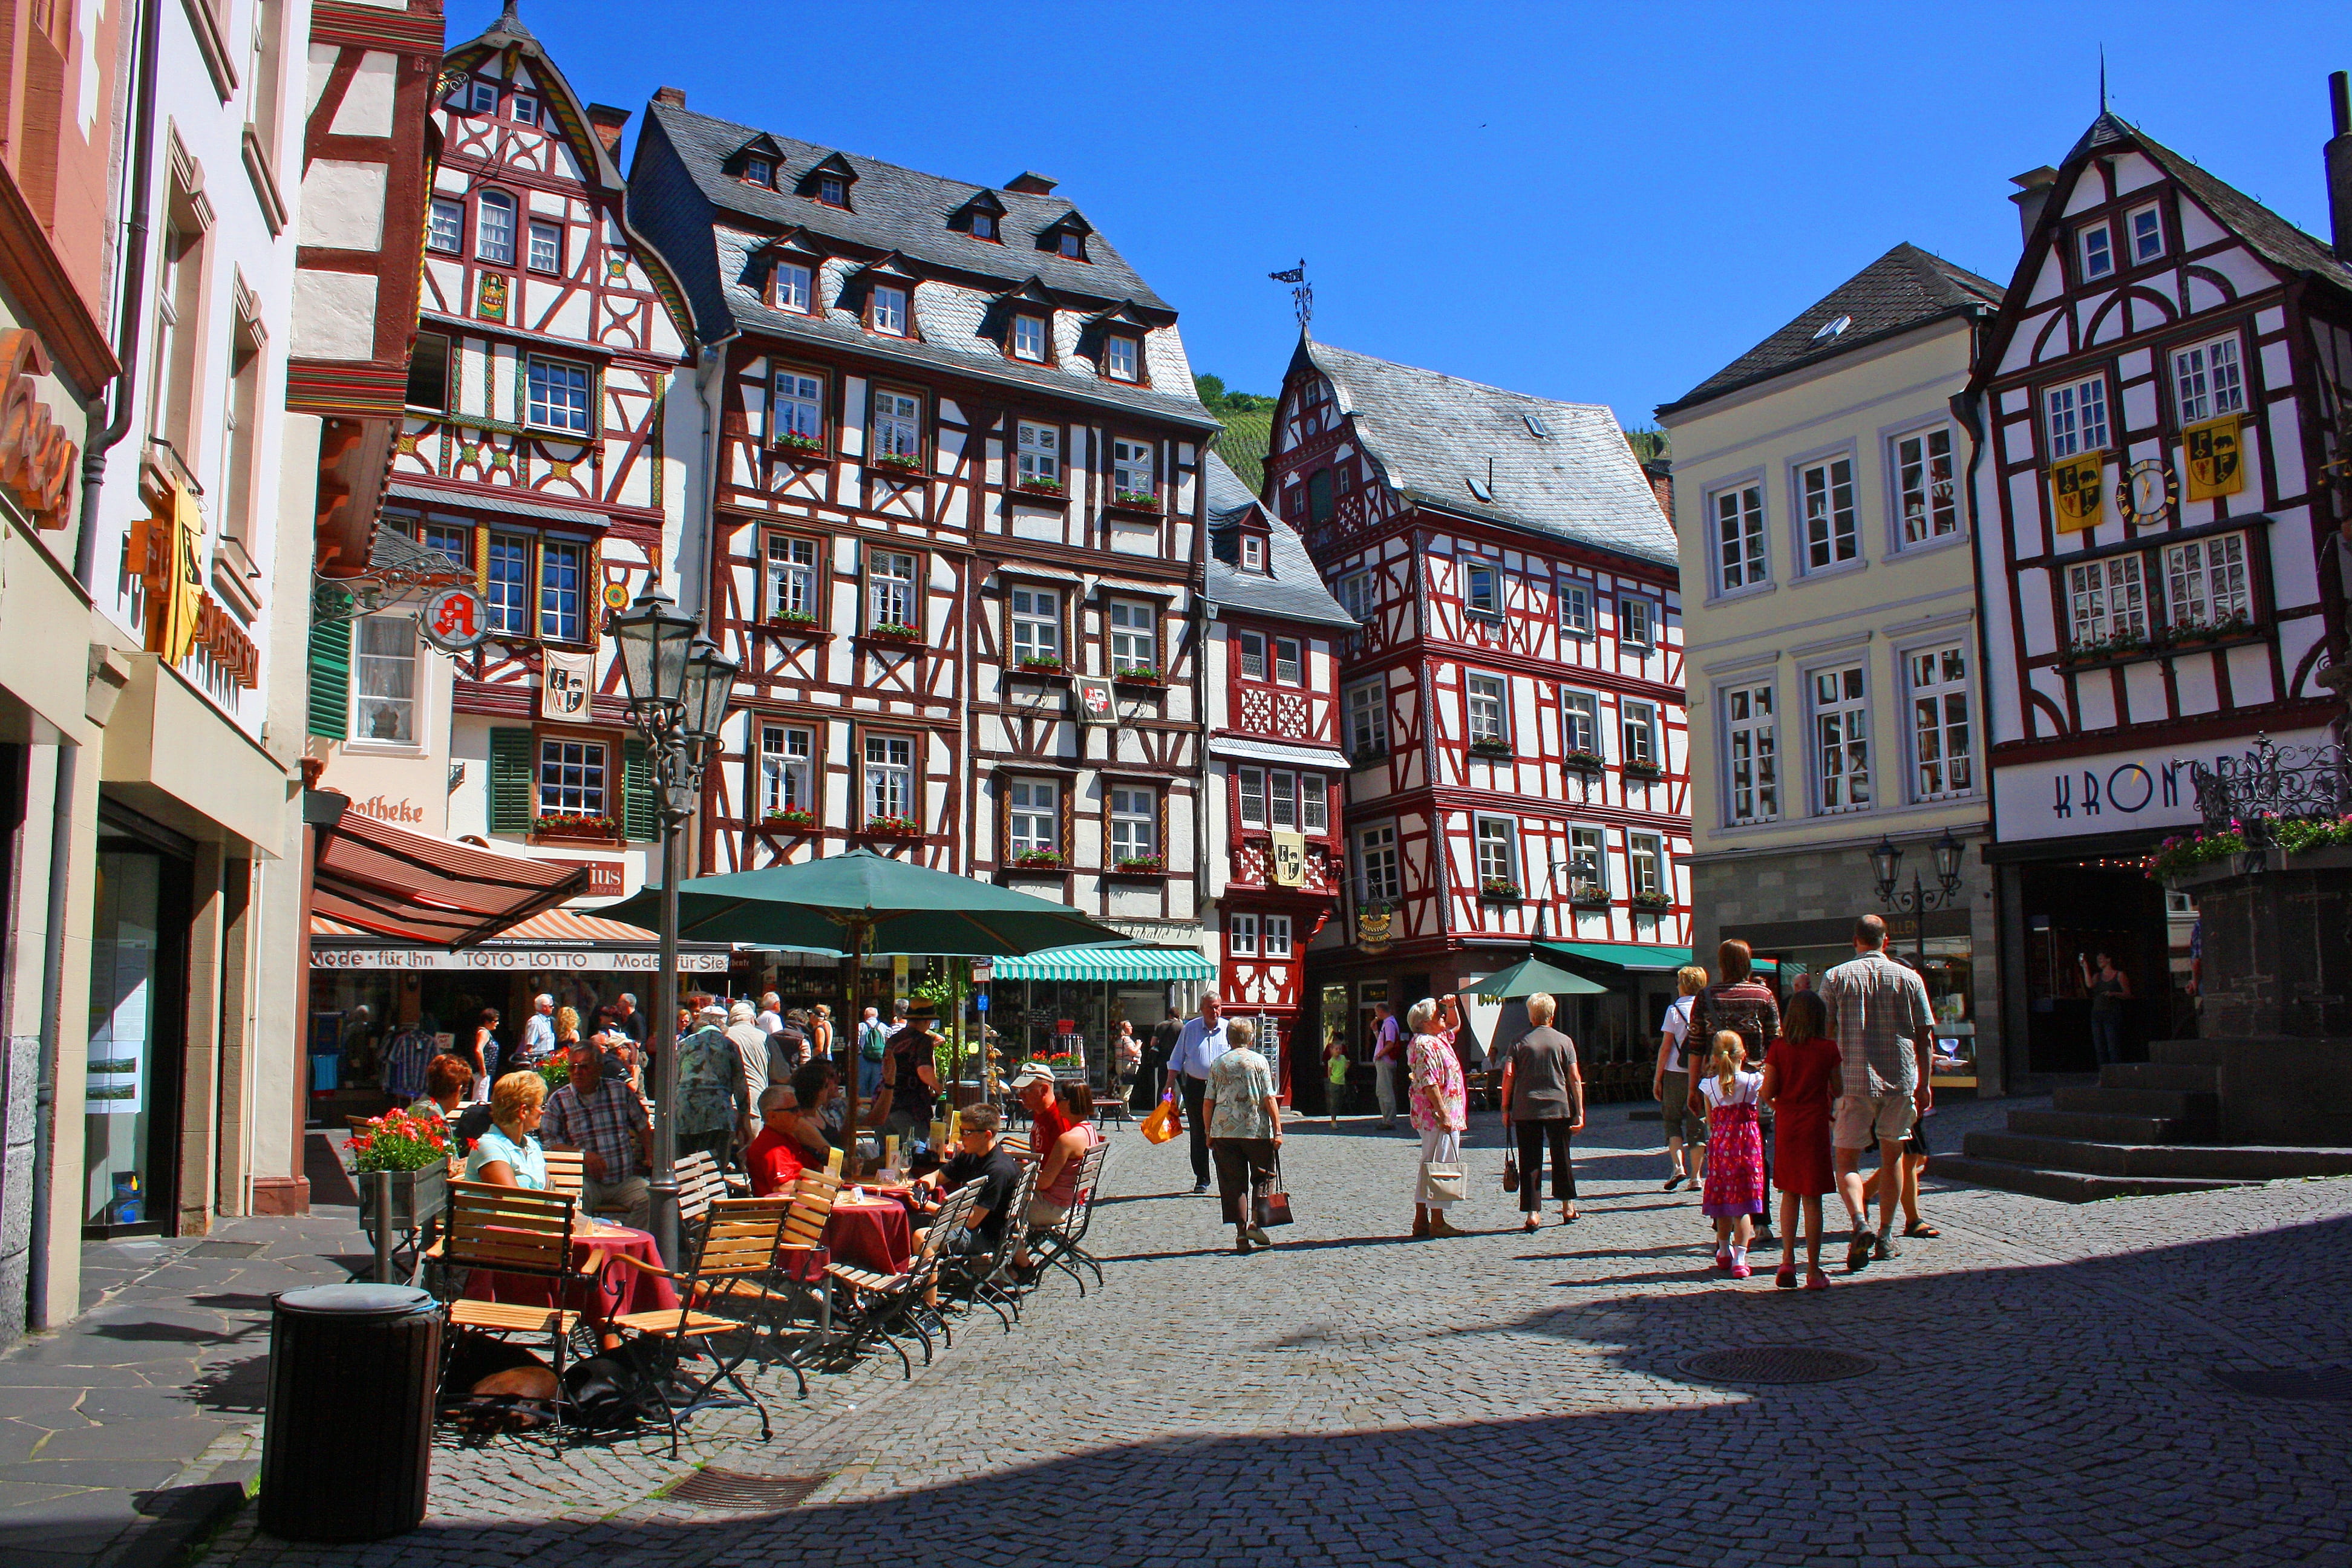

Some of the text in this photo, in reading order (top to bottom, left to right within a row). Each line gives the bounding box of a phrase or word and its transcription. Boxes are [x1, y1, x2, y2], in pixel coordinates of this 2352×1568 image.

[310, 951, 363, 966] Mode
[377, 951, 403, 966] für
[408, 951, 434, 966] Ihn
[463, 952, 515, 967] TOTO
[529, 953, 587, 967] LOTTO
[613, 954, 660, 968] Mode
[699, 955, 725, 969] Sie
